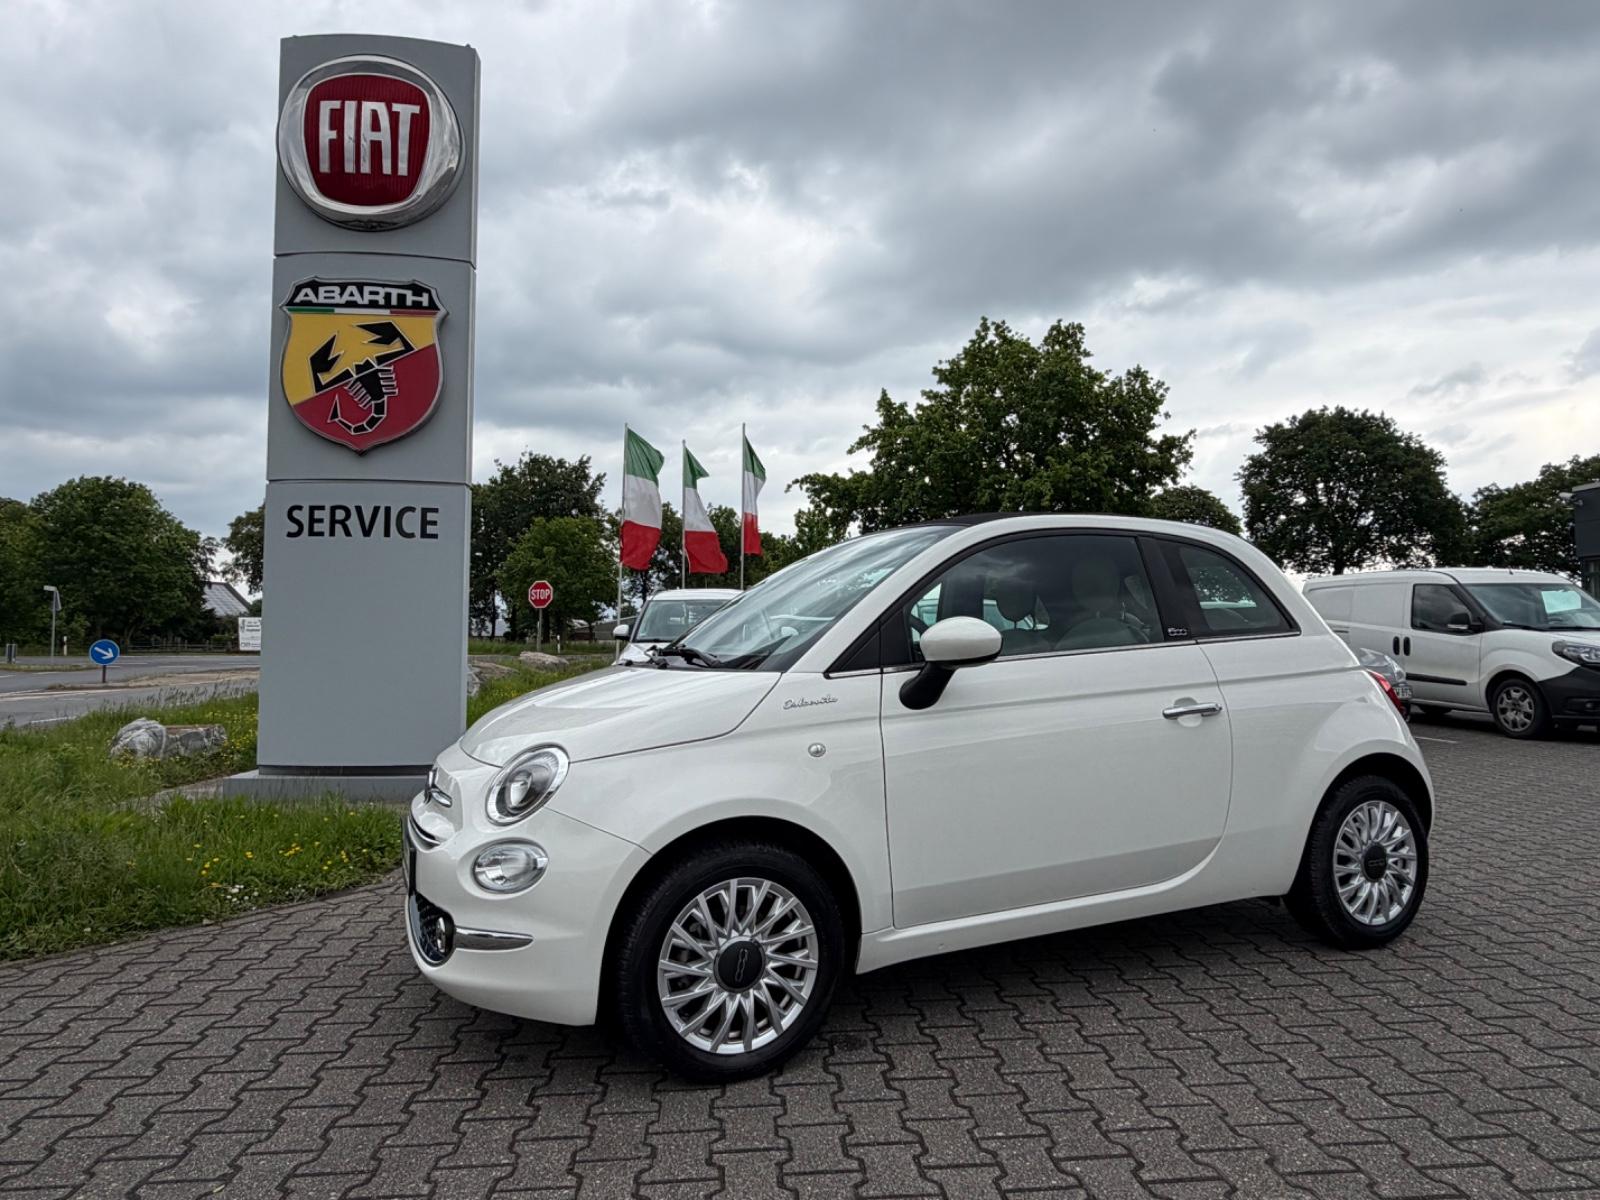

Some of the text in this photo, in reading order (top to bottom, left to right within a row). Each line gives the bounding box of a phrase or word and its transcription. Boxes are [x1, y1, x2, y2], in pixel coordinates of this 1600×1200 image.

[319, 100, 421, 176] FIAT
[293, 285, 429, 307] ABARTH
[286, 504, 440, 539] SERVICE
[531, 588, 550, 600] STOP
